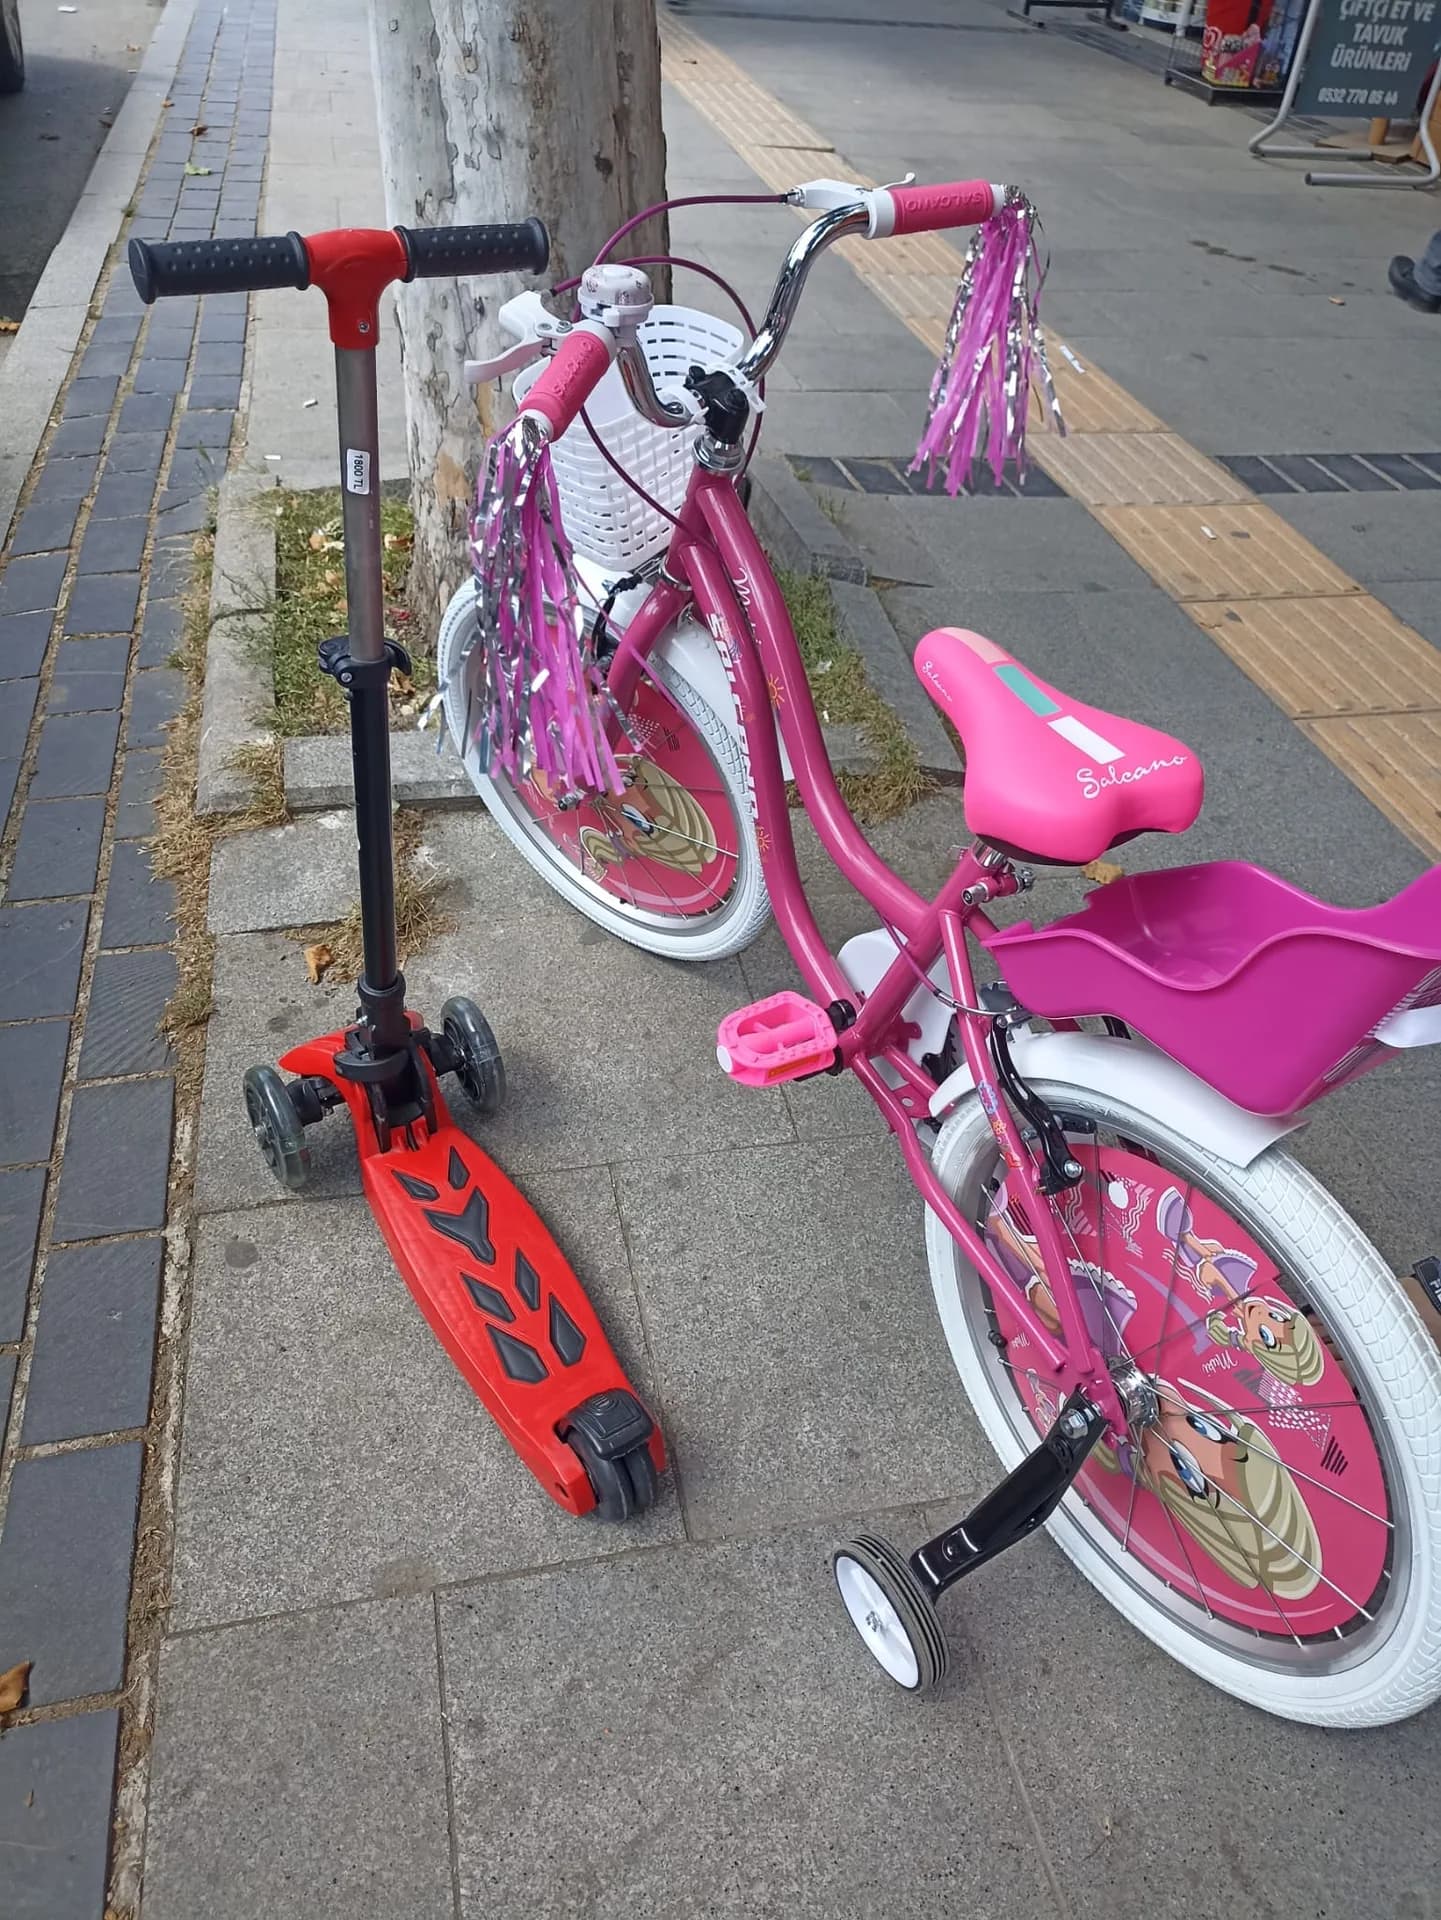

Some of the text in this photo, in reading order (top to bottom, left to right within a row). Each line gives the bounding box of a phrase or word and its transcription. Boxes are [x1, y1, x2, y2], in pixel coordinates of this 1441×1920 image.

[1390, 1, 1412, 20] ET
[1414, 2, 1435, 22] VE
[1352, 23, 1408, 46] TAVUK
[1330, 43, 1412, 72] ÜRÜNLERİ
[904, 191, 985, 213] SALCANO
[353, 454, 364, 490] 1800 TL
[1076, 755, 1188, 799] Salcano
